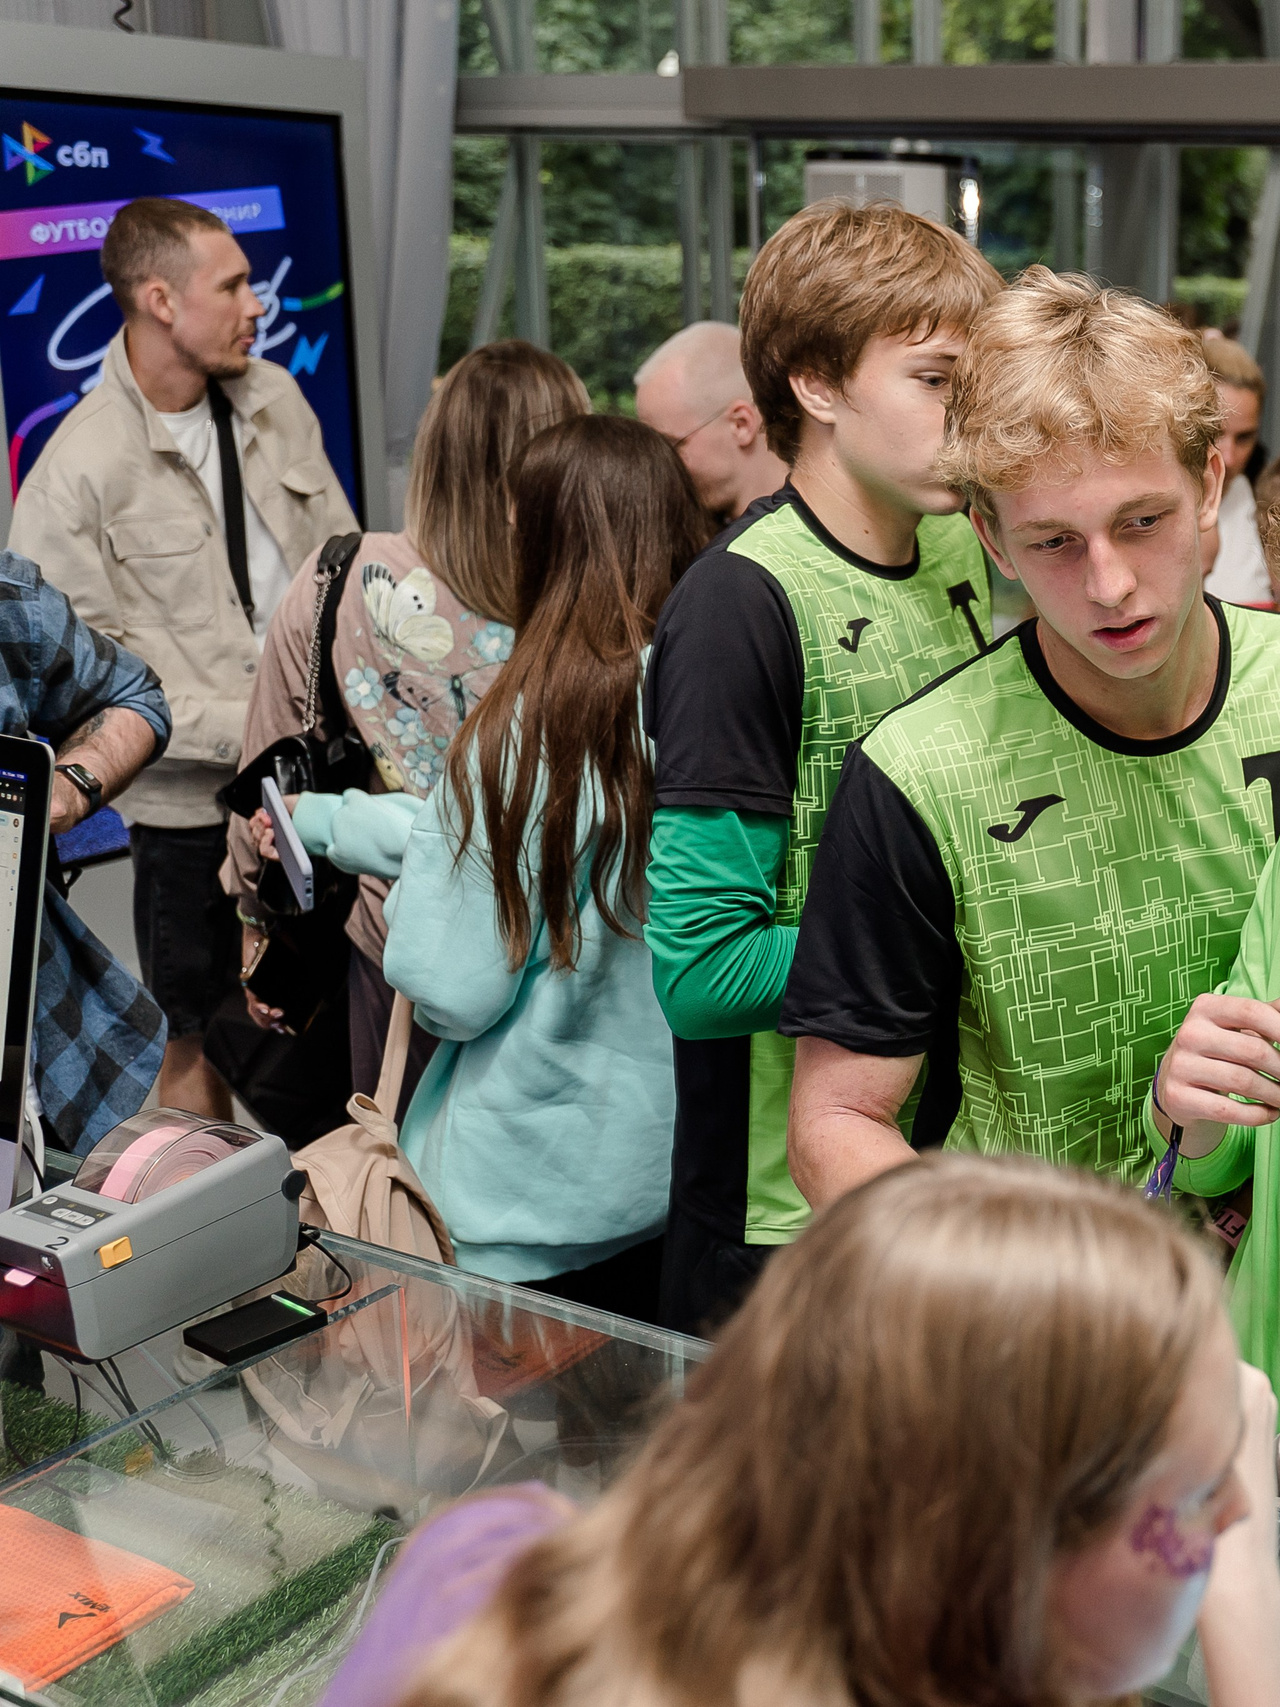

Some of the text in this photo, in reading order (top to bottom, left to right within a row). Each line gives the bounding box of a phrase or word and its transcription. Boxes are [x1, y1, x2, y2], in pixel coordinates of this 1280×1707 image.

[56, 141, 109, 168] сбп
[30, 215, 116, 245] ФУТБО
[45, 1236, 70, 1251] 2
